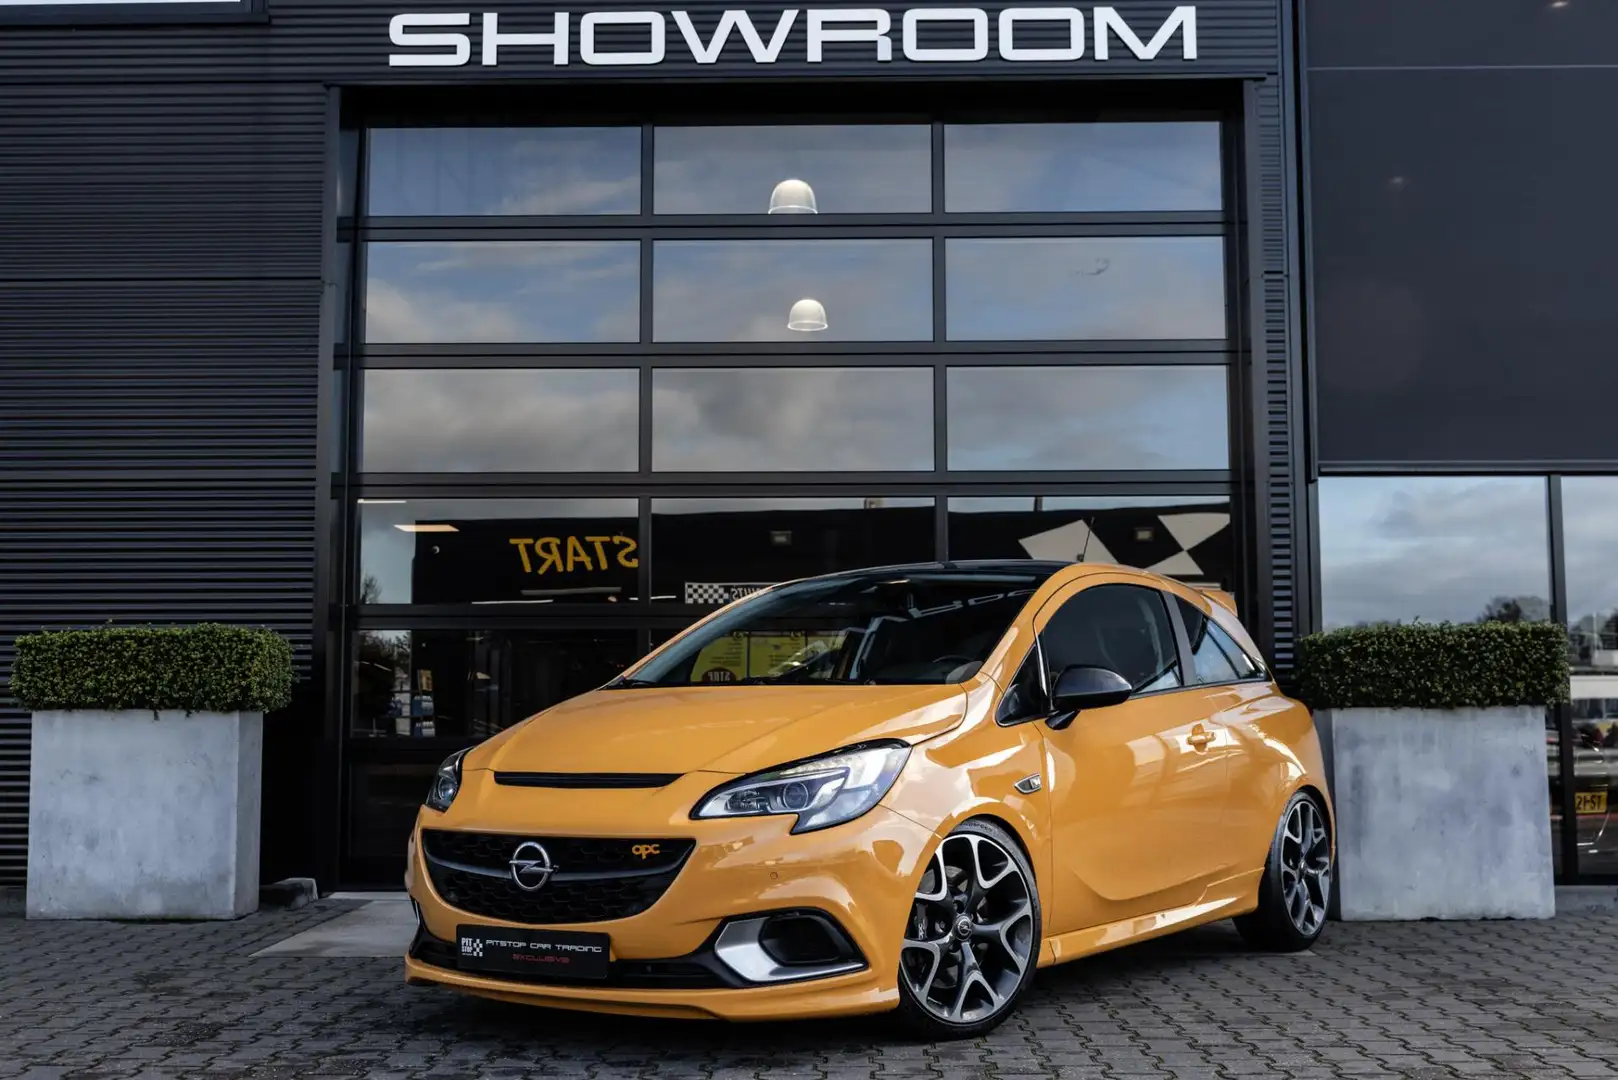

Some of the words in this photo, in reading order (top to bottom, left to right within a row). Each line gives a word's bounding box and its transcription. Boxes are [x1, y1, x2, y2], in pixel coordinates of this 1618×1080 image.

[388, 6, 1198, 67] SHOWROOM
[632, 843, 660, 860] opc
[461, 937, 473, 947] PIT
[485, 939, 527, 948] PITSTOP
[529, 942, 552, 950] CAR
[555, 944, 602, 953] TRADING
